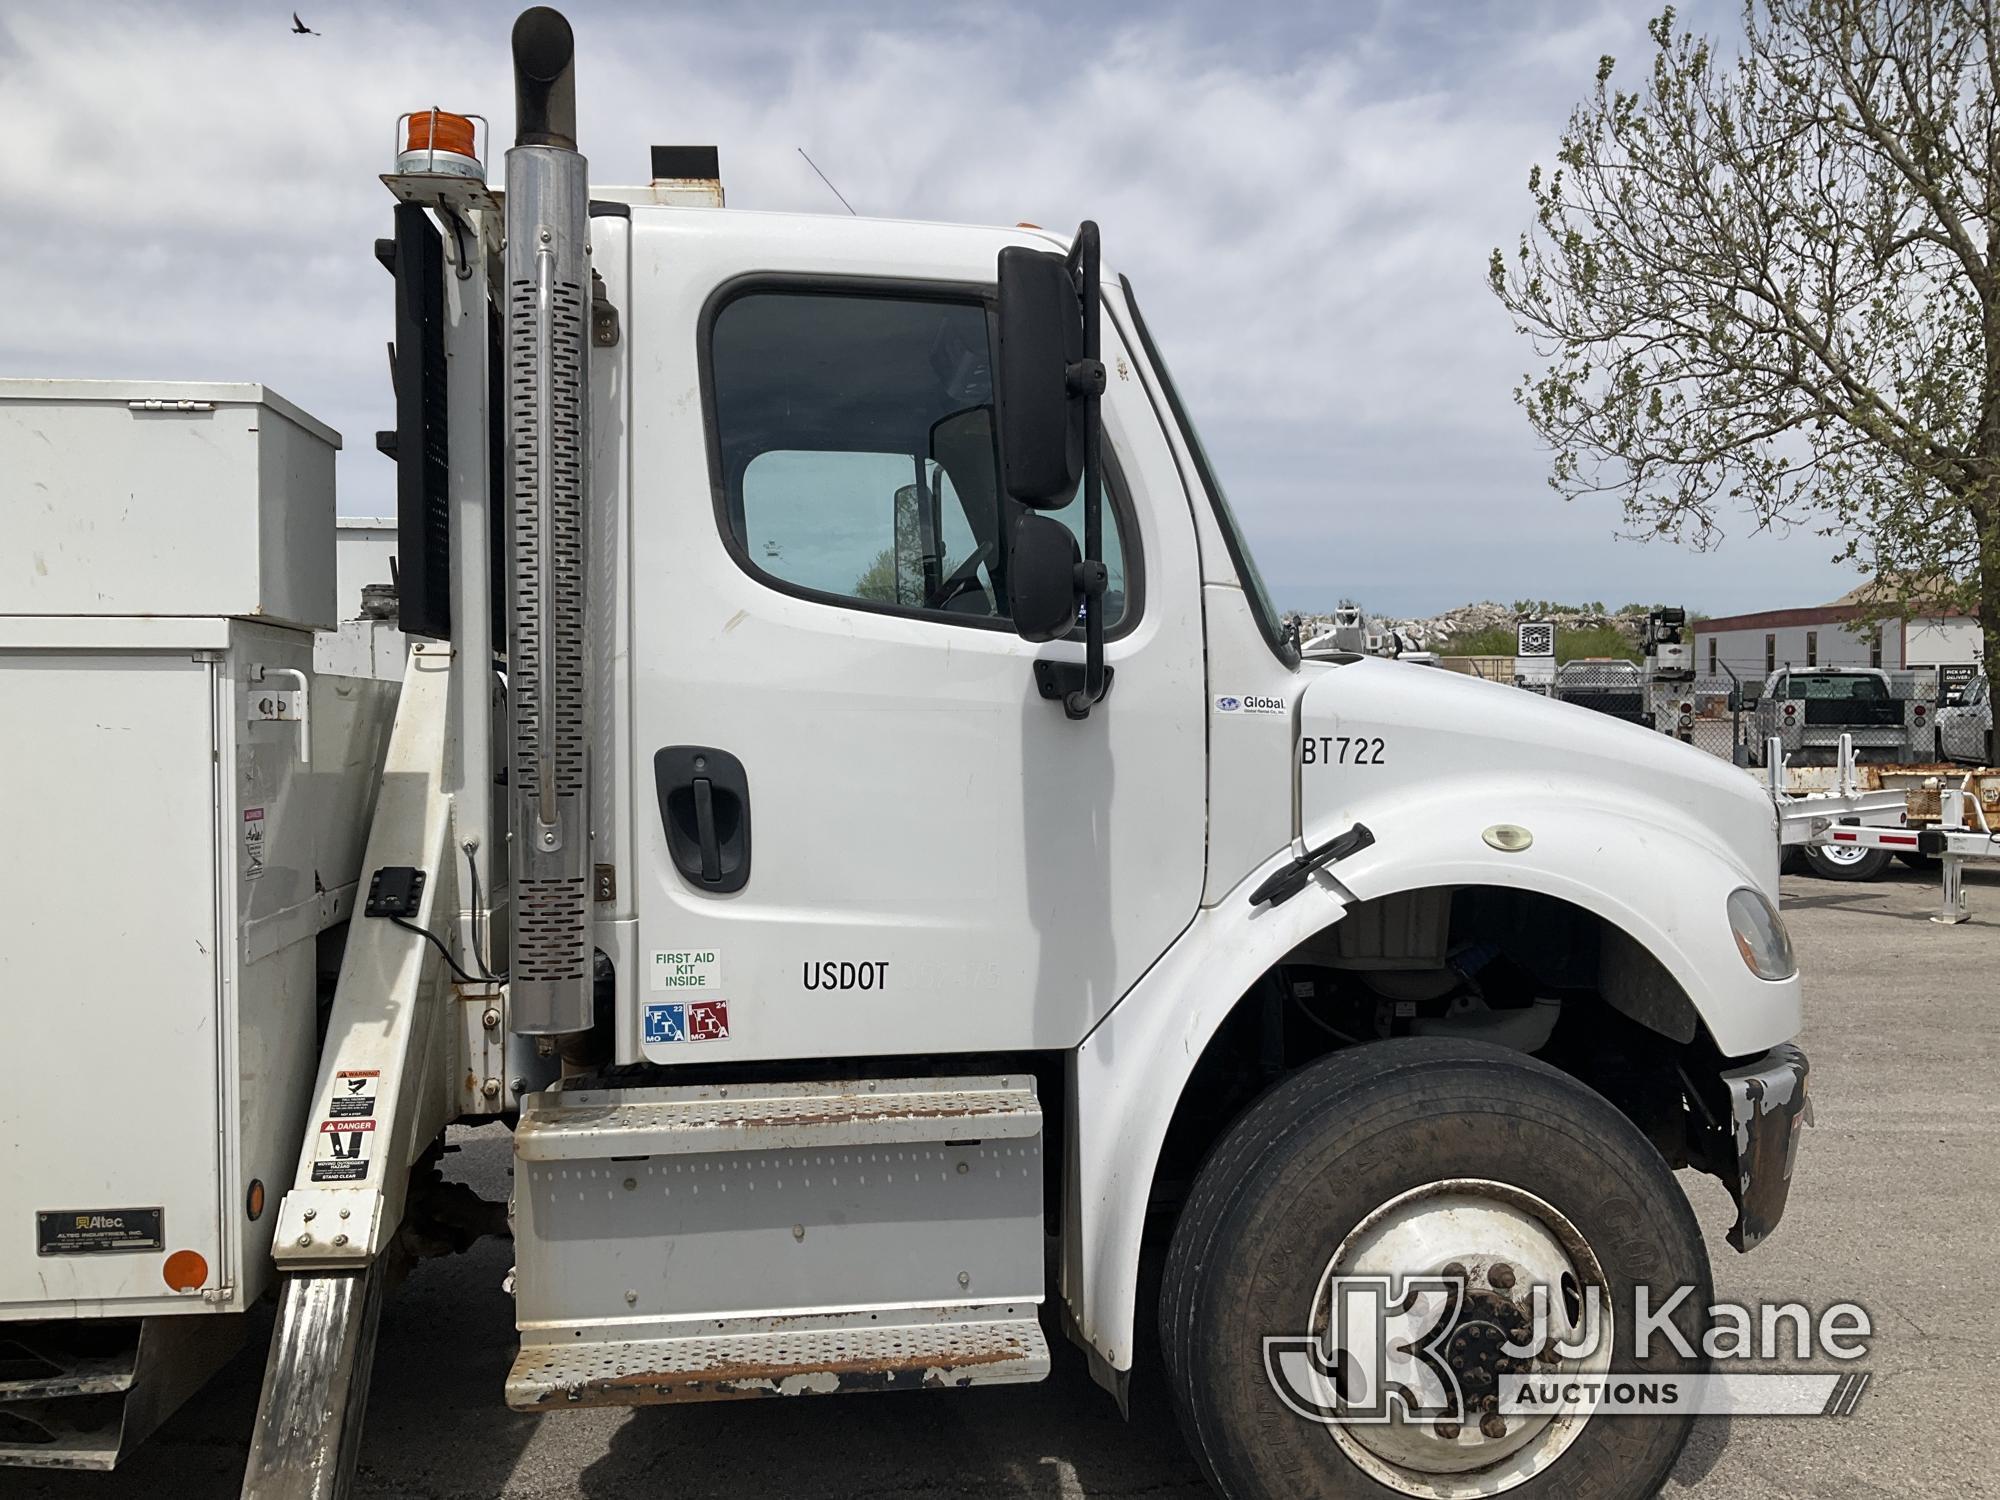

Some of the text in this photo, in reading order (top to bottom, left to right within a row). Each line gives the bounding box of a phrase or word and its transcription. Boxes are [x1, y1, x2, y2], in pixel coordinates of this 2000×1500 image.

[1244, 696, 1284, 709] Global
[1302, 737, 1385, 765] BT722
[656, 952, 715, 964] FIRST AID
[676, 964, 695, 975] KIT
[665, 975, 706, 987] INSIDE
[803, 961, 889, 991] USDOT
[338, 1122, 372, 1130] DANGER
[90, 1216, 123, 1228] Altec
